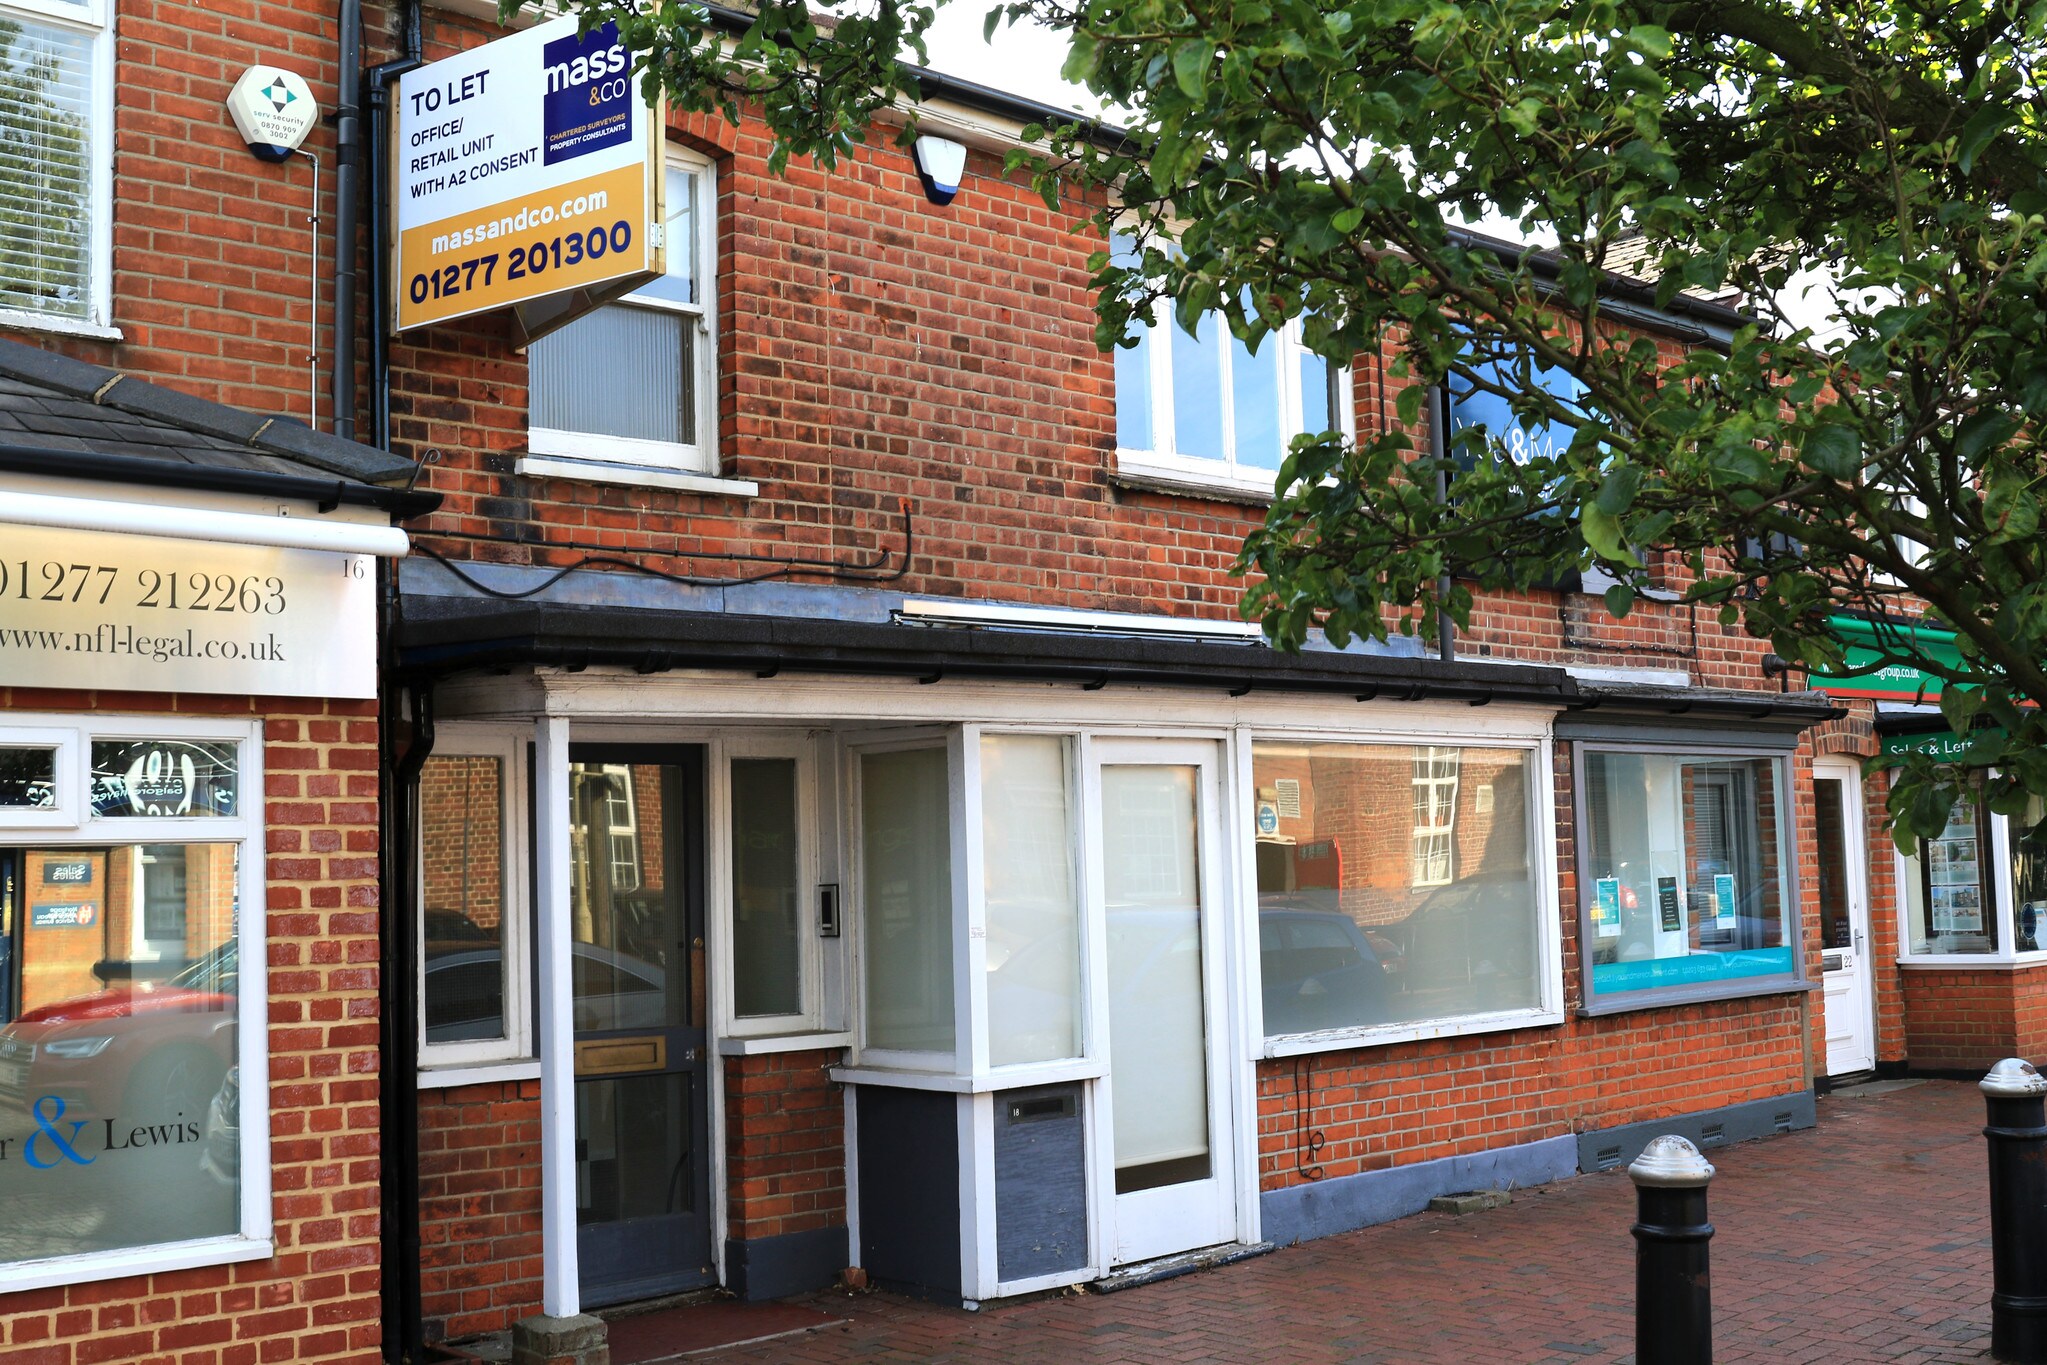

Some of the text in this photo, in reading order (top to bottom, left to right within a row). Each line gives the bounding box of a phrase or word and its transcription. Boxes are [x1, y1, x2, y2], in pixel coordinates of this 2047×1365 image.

[544, 44, 624, 95] mass
[410, 70, 490, 116] TO LET
[589, 78, 626, 106] &CO
[261, 121, 297, 133] 0870 909
[270, 130, 288, 139] 3002
[273, 114, 304, 126] security
[411, 117, 464, 147] OFFICE/
[550, 112, 626, 142] CHARTERED SURVEYORS
[550, 123, 626, 152] PROPERTY CONSULTANTS
[411, 134, 494, 174] RETAIL UNIT
[410, 147, 538, 199] WITH A2 CONSENT
[432, 190, 608, 254] massandco.com
[410, 220, 632, 304] 01277 201300
[342, 559, 364, 579] 16
[136, 568, 287, 615] 212263
[1929, 745, 1939, 754] &
[1844, 955, 1852, 968] 22
[1013, 1108, 1020, 1117] 18
[23, 1095, 96, 1169] &
[102, 1112, 199, 1150] Lewis
